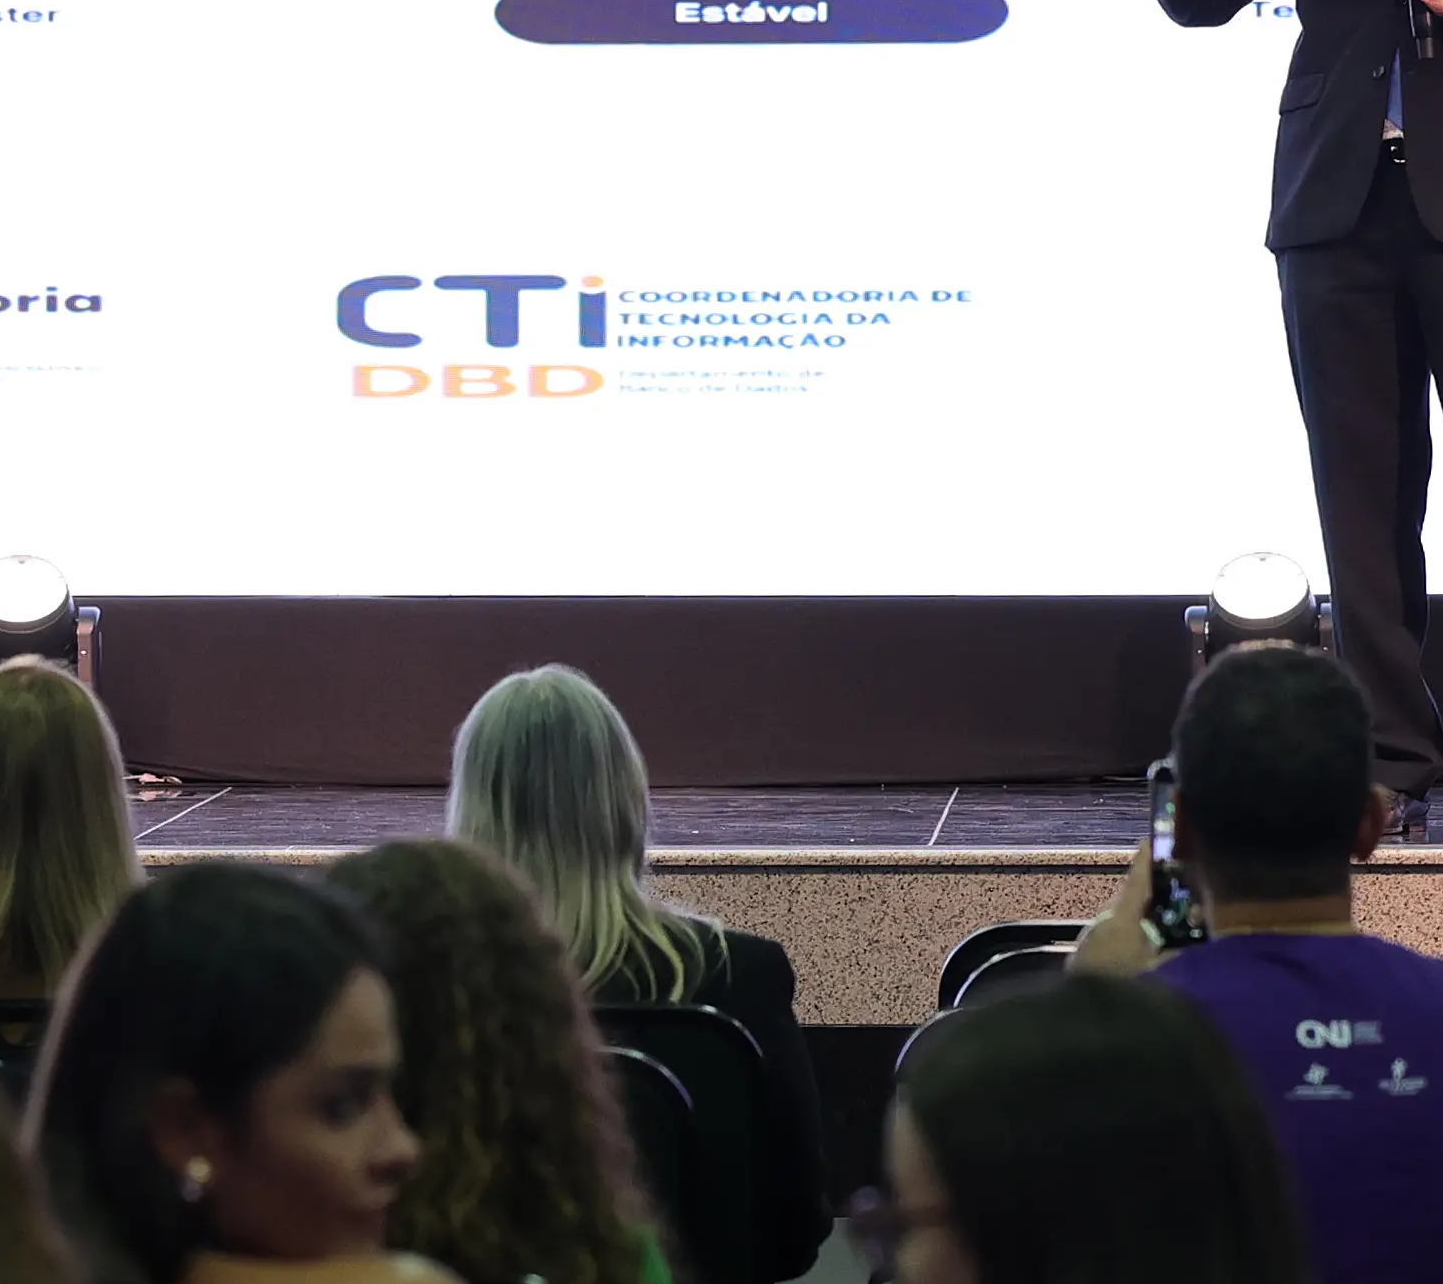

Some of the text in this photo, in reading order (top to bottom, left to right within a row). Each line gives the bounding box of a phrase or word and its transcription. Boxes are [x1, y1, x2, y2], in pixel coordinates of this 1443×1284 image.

[675, 1, 828, 23] Estável
[619, 291, 969, 303] COORDENADORIA DE
[620, 313, 890, 325] TECNOLOGIA DA
[618, 333, 846, 349] INFORMAÇÃO
[354, 364, 605, 398] DBD
